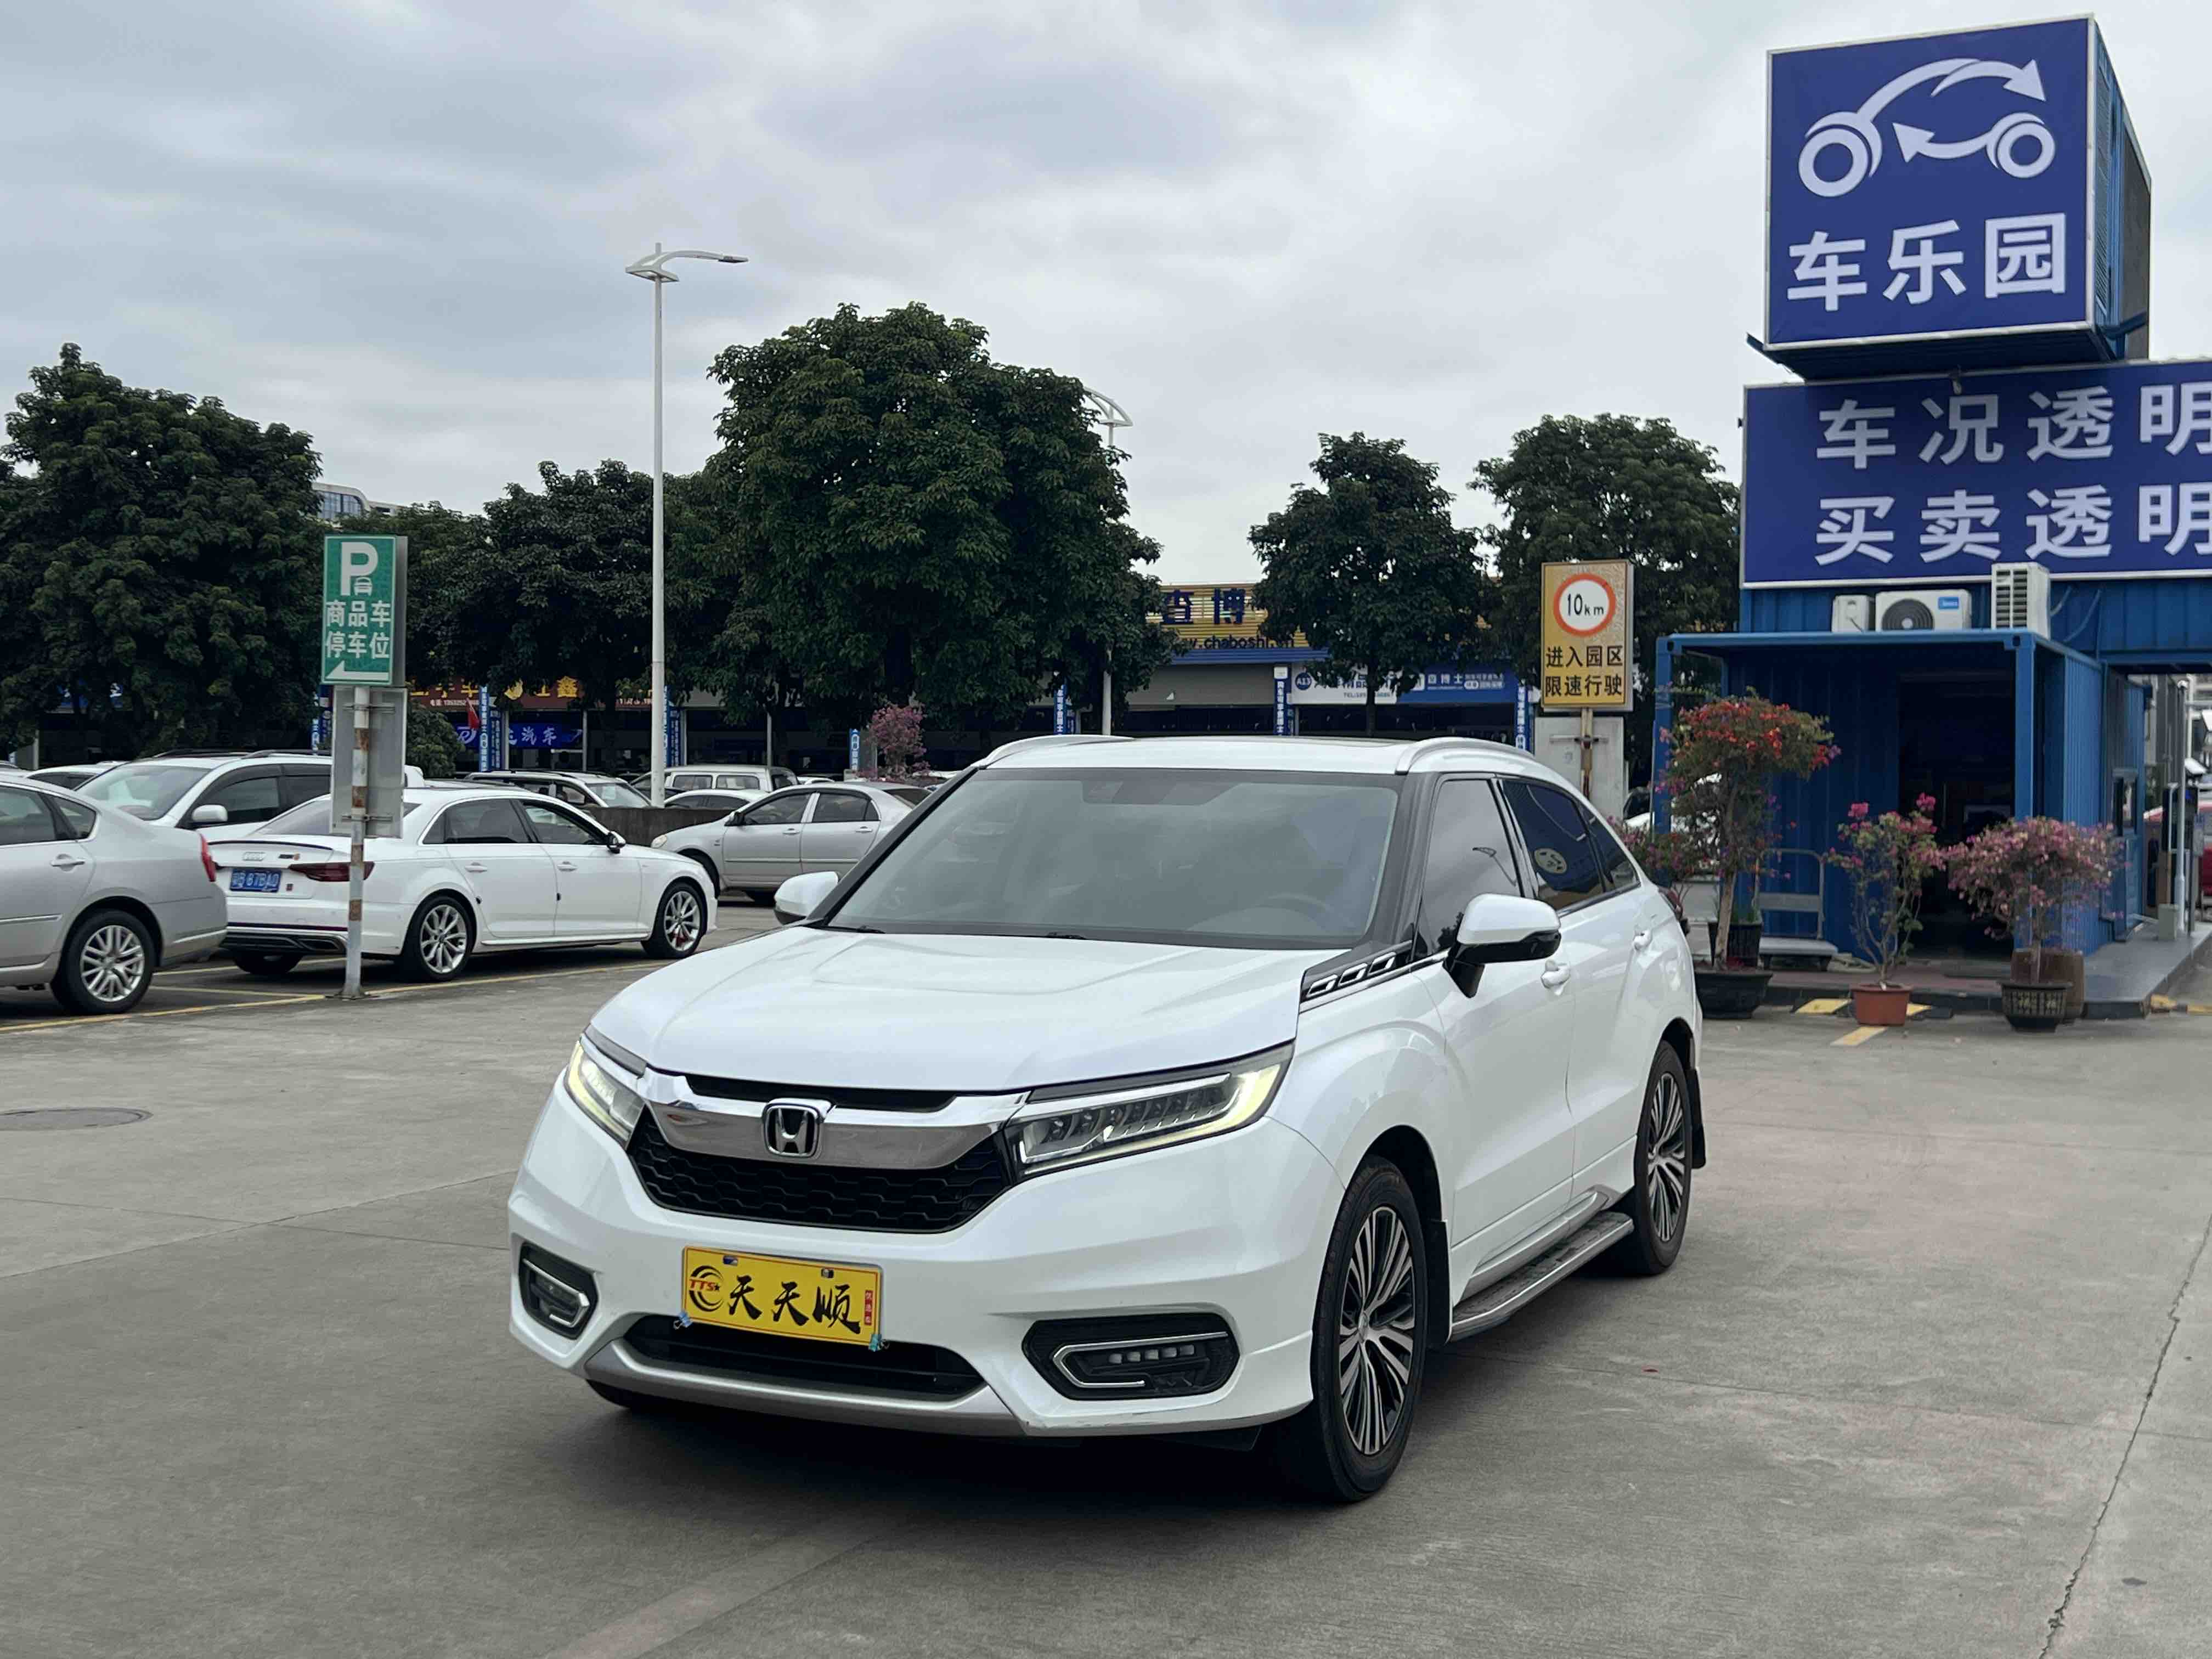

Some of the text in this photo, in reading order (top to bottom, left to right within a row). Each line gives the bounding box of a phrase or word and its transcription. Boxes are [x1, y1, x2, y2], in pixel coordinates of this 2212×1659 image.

[1787, 213, 2066, 311] 车乐园
[1816, 381, 2212, 469] 车况透明
[1814, 482, 2212, 566] 买卖透明
[340, 541, 379, 596] P
[325, 599, 391, 628] 商品车
[1567, 593, 1604, 616] 10km
[325, 631, 391, 659] 停车位
[1545, 645, 1623, 668] 进入园区
[1545, 674, 1622, 697] 限速行驶
[726, 1274, 861, 1334] 天天顺
